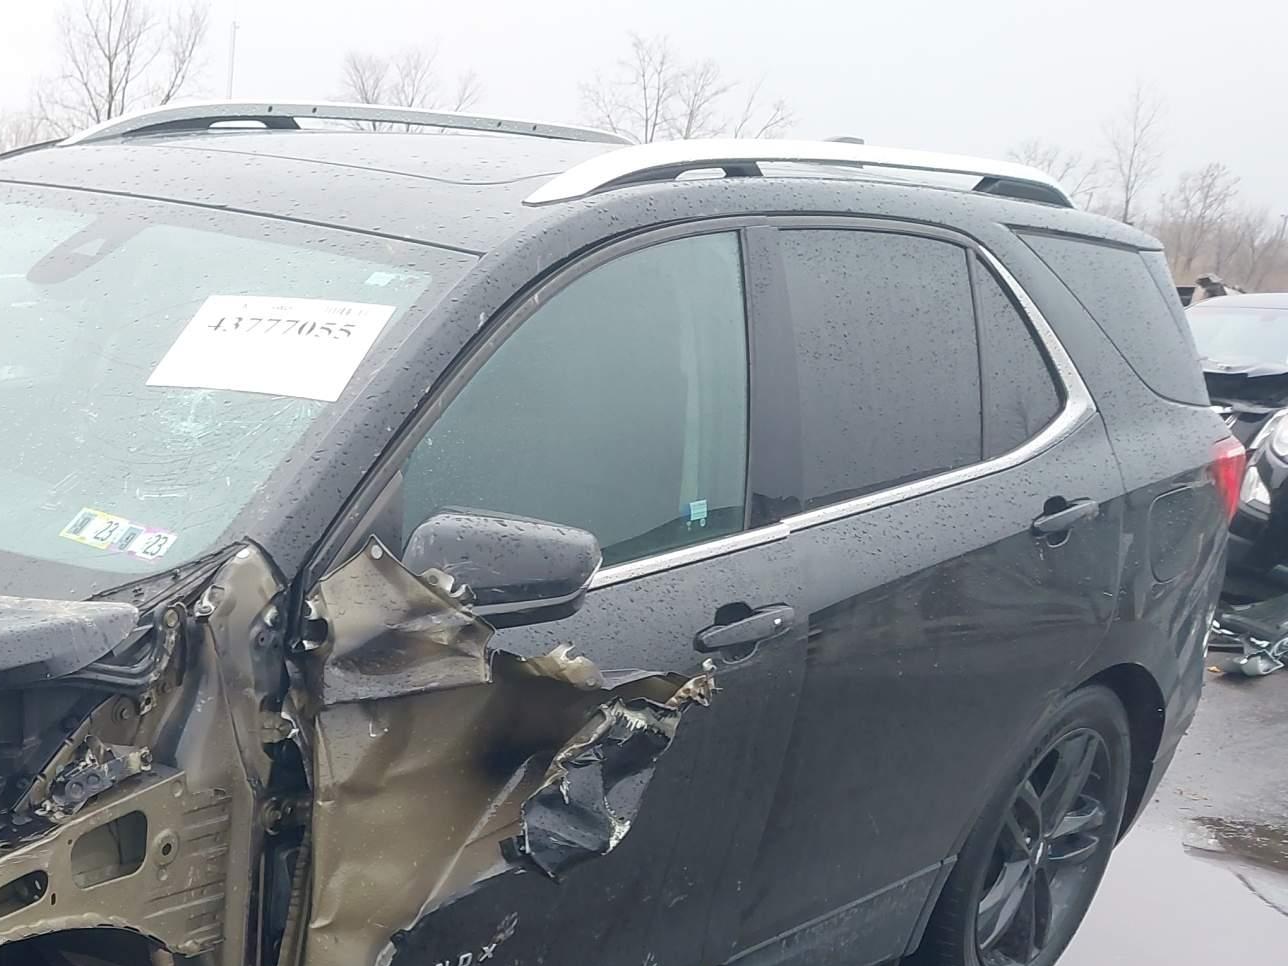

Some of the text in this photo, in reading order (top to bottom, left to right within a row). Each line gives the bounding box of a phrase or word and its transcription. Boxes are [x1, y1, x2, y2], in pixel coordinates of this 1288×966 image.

[208, 316, 356, 339] 43777055
[94, 520, 120, 542] 23
[142, 535, 169, 556] 23
